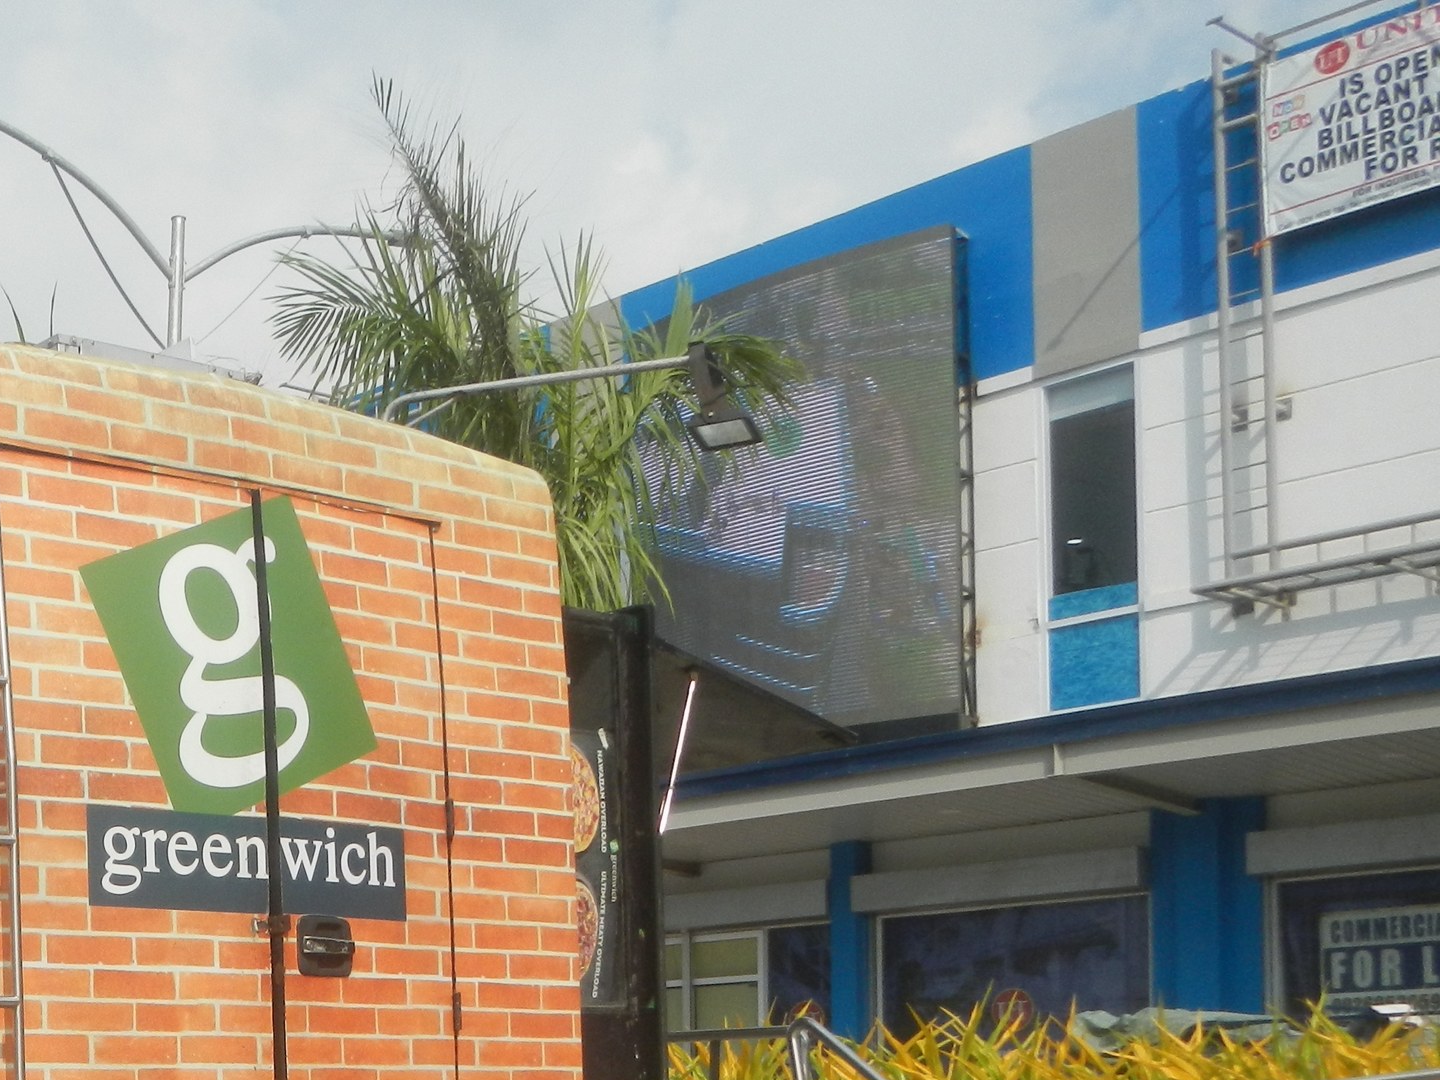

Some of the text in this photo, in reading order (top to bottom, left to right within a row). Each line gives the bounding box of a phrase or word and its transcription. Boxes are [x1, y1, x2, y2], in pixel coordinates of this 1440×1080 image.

[1318, 72, 1429, 126] VACANT
[1339, 72, 1364, 98] IS
[1265, 113, 1312, 140] OPEN
[1318, 91, 1440, 150] BILLBOA
[1364, 146, 1419, 180] FOR
[159, 535, 310, 788] g
[599, 801, 608, 853] OVERLOAD
[101, 825, 396, 895] greenwich
[609, 854, 618, 902] greenwich
[591, 871, 607, 998] ULTIMATE MEATY OVERLOAD
[1330, 948, 1402, 989] FOR
